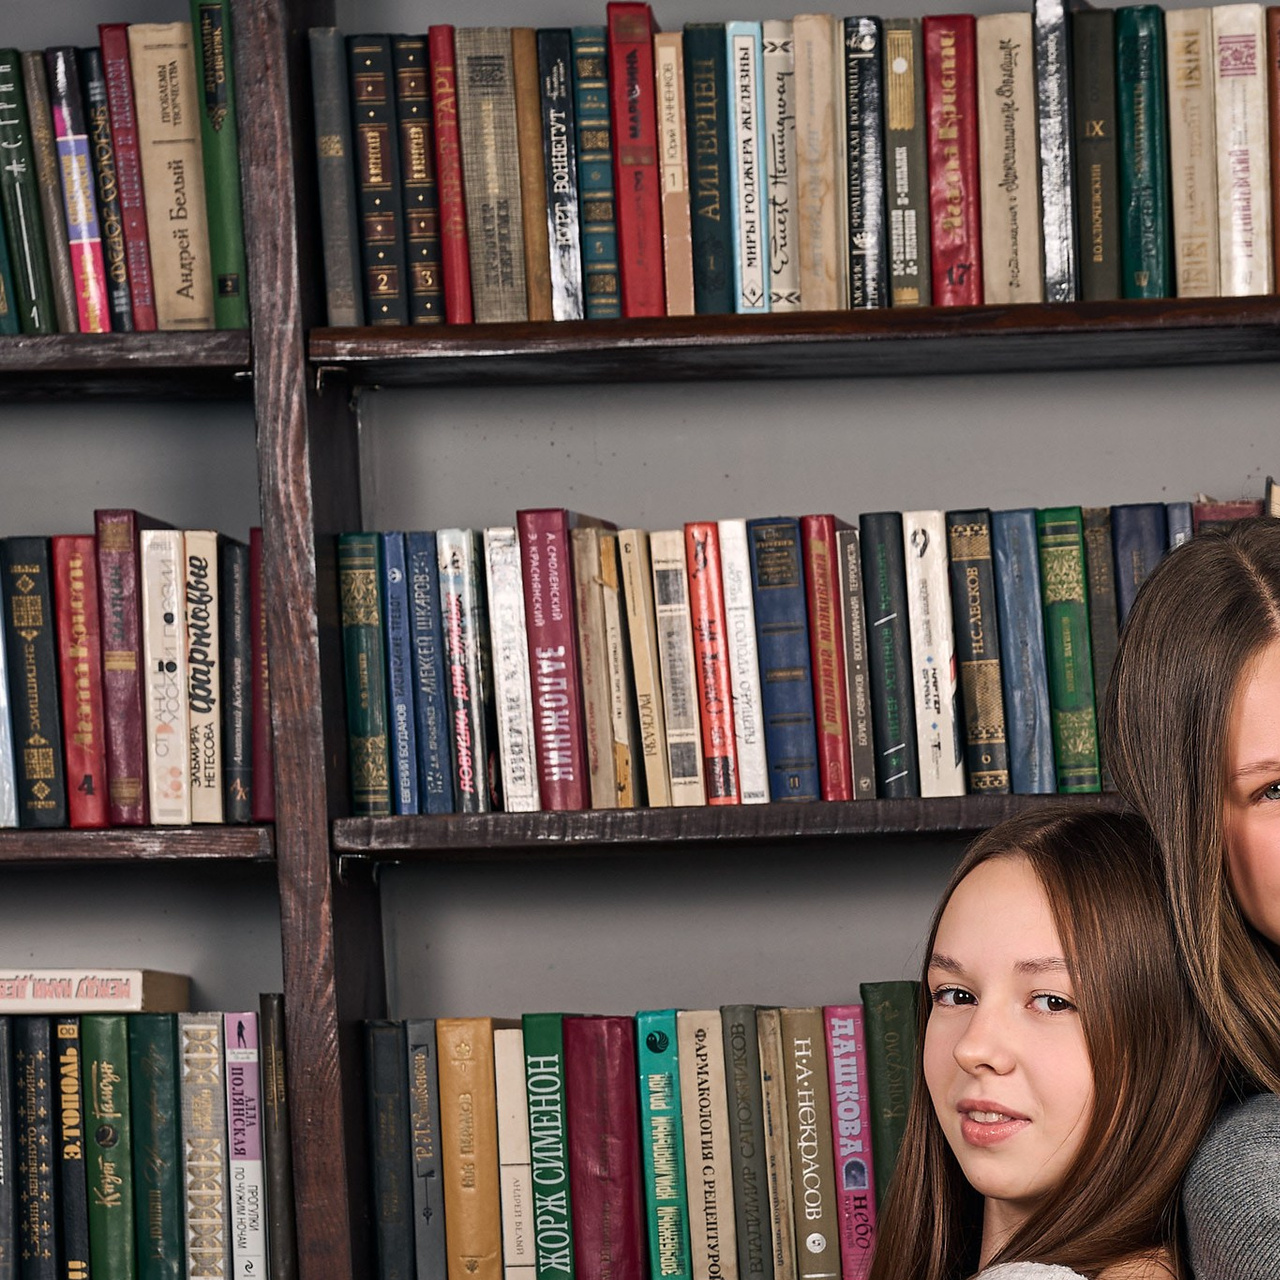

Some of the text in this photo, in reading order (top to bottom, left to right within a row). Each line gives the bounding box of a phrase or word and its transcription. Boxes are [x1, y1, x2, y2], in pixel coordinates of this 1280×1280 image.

[168, 60, 183, 127] ТВОРЧЕСТВА
[662, 62, 679, 160] Юрий АННЕНКОВ
[550, 108, 572, 250] КУРТ ВОННЕГУТ
[739, 46, 757, 269] МИРЫ РОДЖЕРА ЖЕЛЯЗНЫ
[168, 160, 196, 300] Андрей Белый
[110, 565, 126, 642] ЗЛАТКИН
[815, 553, 838, 724] ВЛАДИМИР МАЯКОВСКИЙ
[847, 543, 868, 747] БОРИС САВИНКОВ ВОСПОМИНАНИЯ ТЕРРОРИСТА
[418, 635, 436, 695] АЛЕКСЕЙ
[536, 645, 573, 781] ЗАЛОЖНИК
[189, 725, 201, 788] ЭЛЬМИРА
[203, 722, 216, 789] НЕТЕСОВА
[396, 704, 412, 804] ЕВГЕНИЙ БОГДАНОВ
[232, 1066, 246, 1156] ПОЛЯНСКАЯ
[244, 1095, 256, 1127] АЛЛА
[694, 1027, 713, 1162] ФАРМАКОЛОГИЯ
[831, 1017, 862, 1157] ДАШКОВА
[526, 1052, 572, 1273] ЖОРЖ СИМЕНОН
[648, 1072, 683, 1276] ЗАРУБЕЖНЫЙ КРИМИНАЛЬНЫЙ РОМАН
[703, 1165, 715, 1175] С
[730, 1022, 765, 1274] ВЛАДИМИР САПОЖНИКОВ
[249, 1184, 259, 1231] ПРОГУЛКИ
[852, 1195, 872, 1250] Небо
